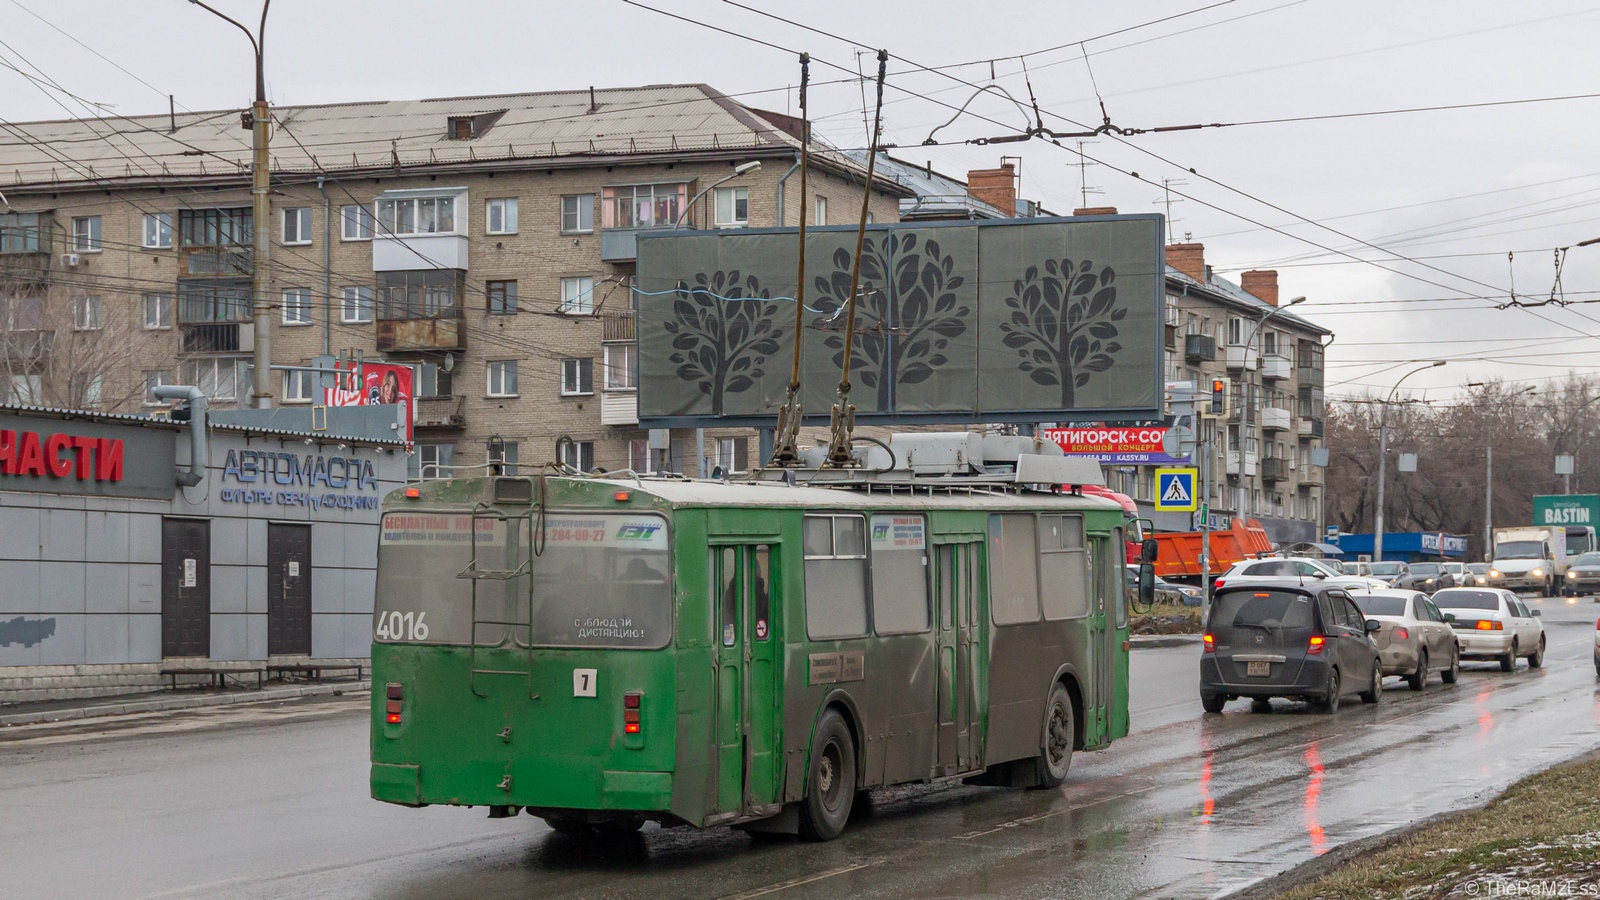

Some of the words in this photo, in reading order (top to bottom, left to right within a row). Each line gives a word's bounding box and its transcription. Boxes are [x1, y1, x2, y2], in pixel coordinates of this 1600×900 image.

[222, 449, 378, 490] АВТОМАСЛА
[221, 488, 273, 504] ФИЛЬТРЫ
[277, 491, 310, 507] СВЕЧИ
[1545, 508, 1590, 523] BASTIN
[376, 610, 430, 641] 4016
[578, 628, 644, 638] ДИСТАНЦИЮ!
[581, 674, 589, 691] 7
